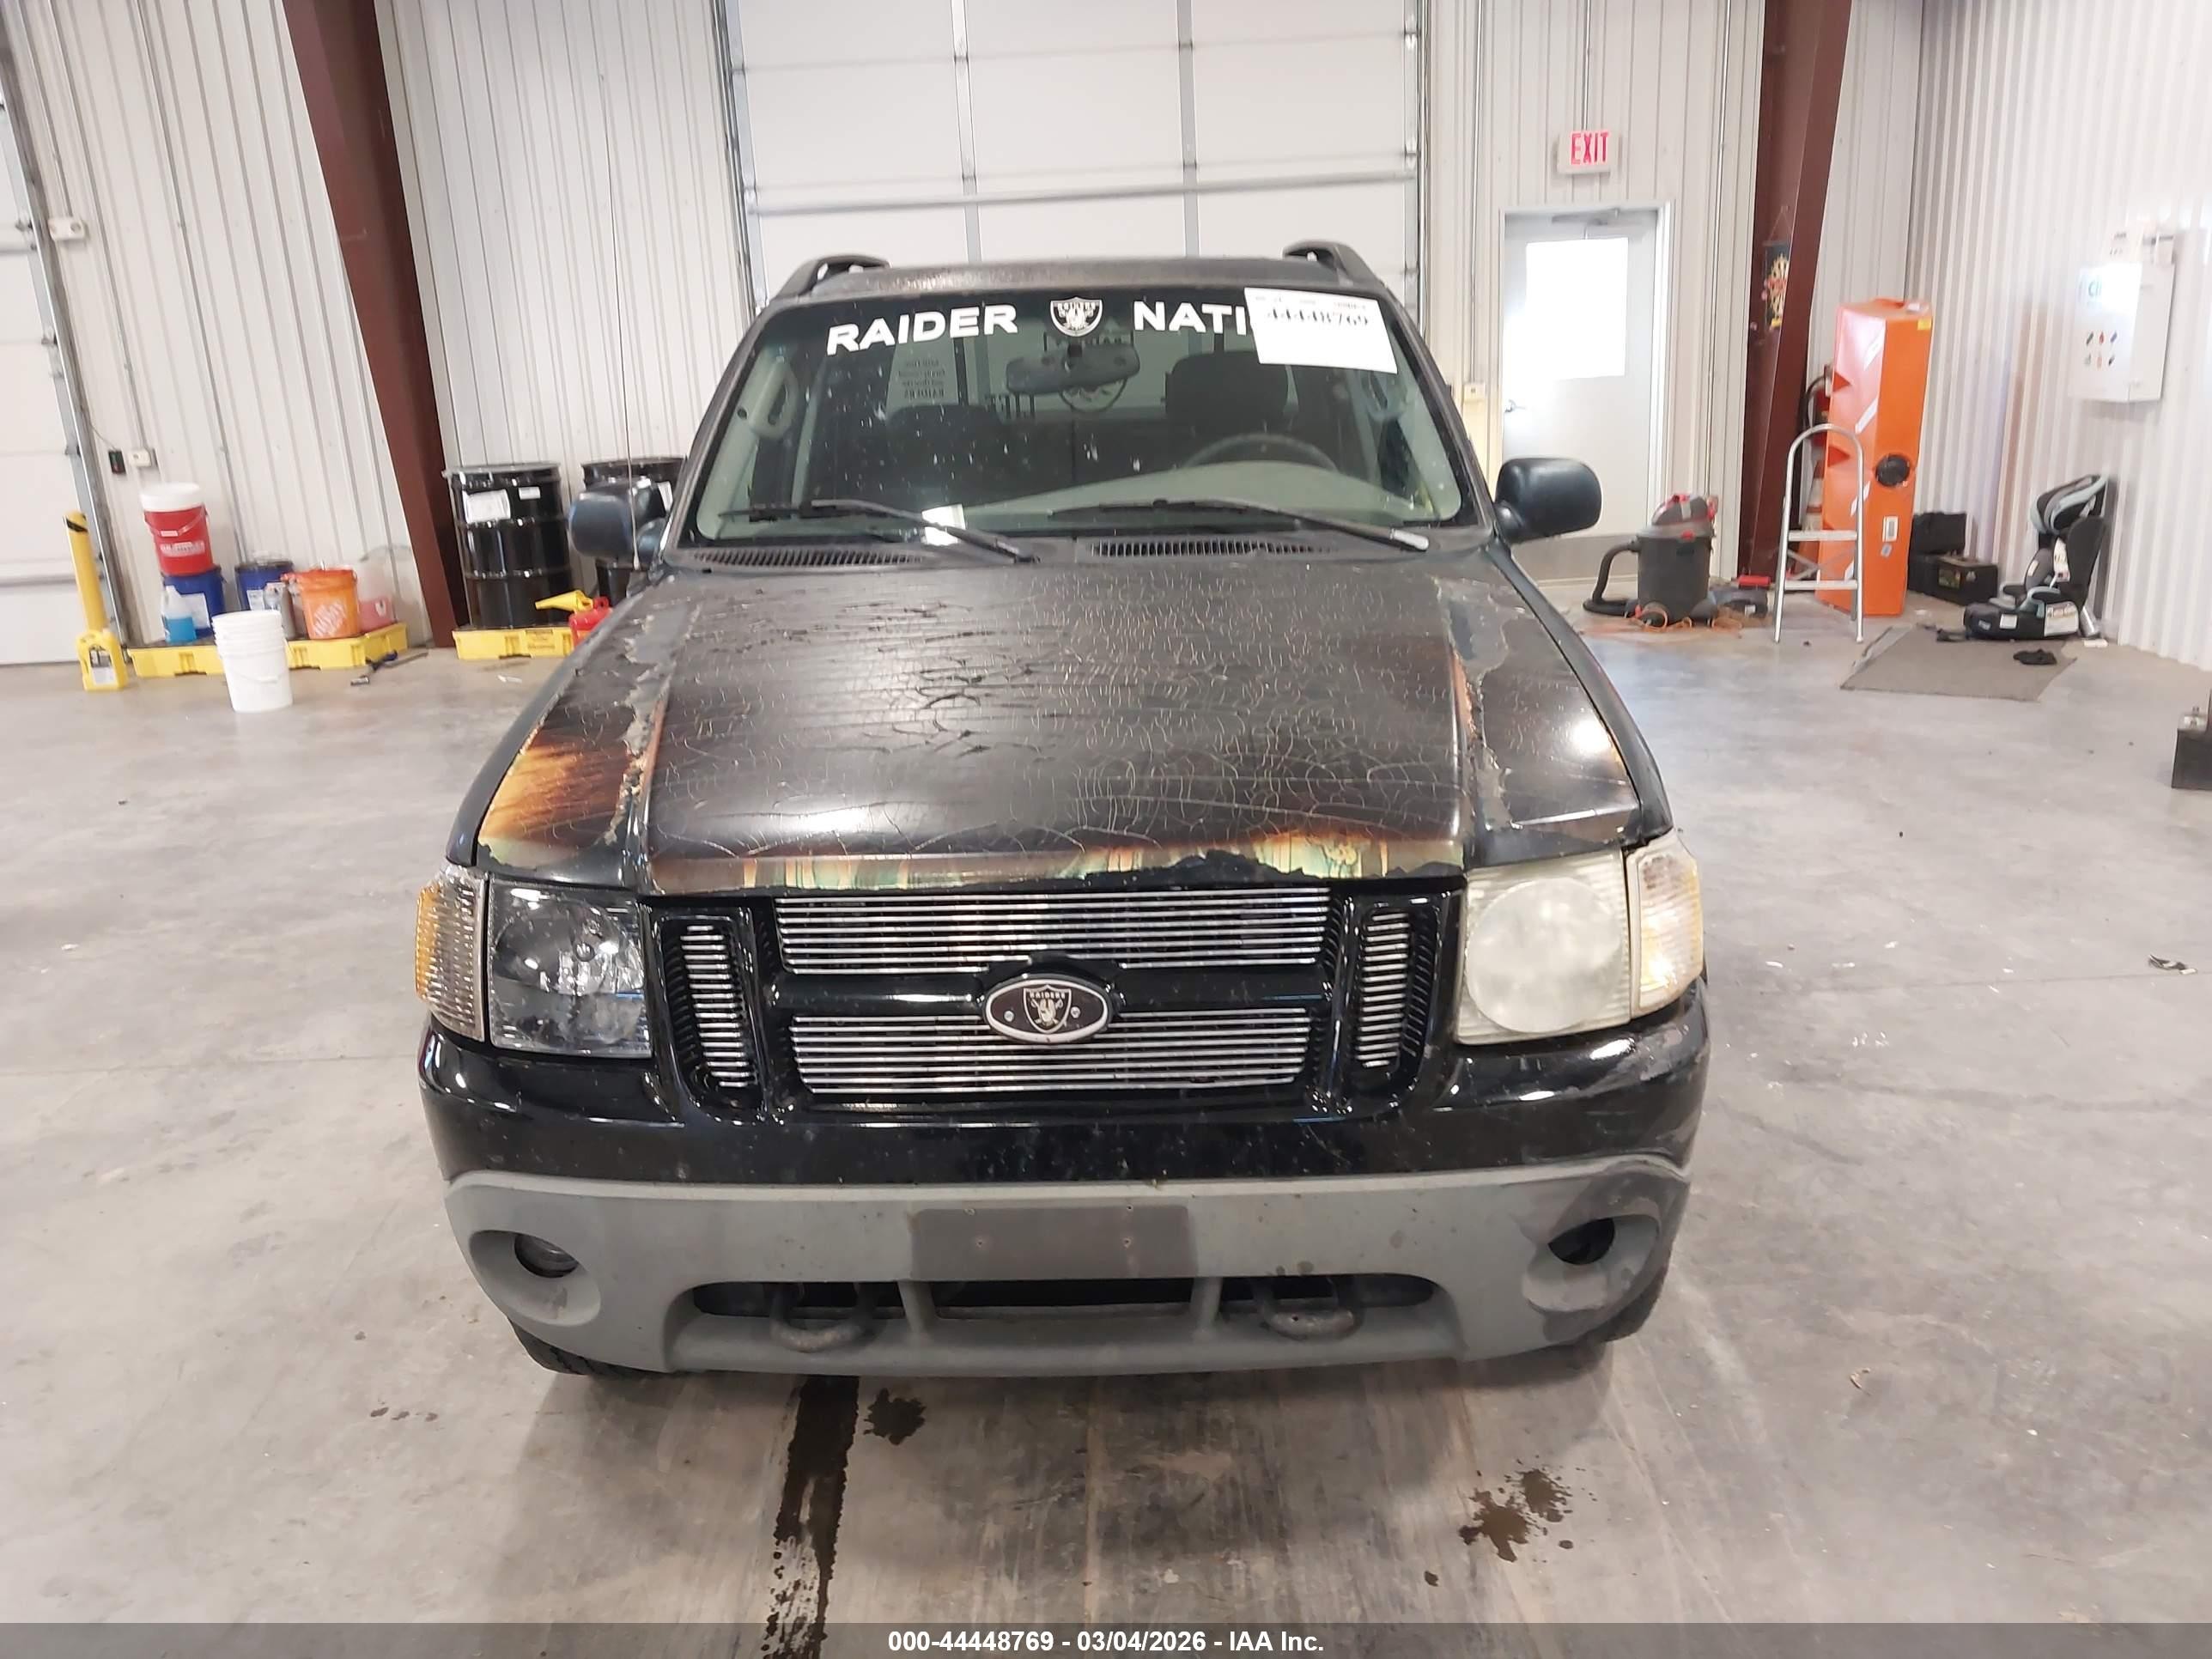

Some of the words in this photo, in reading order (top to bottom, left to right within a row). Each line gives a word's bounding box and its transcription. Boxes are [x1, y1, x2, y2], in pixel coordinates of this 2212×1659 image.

[1571, 131, 1608, 165] EXIT
[827, 304, 1018, 356] RAIDER
[1133, 301, 1246, 335] NATI
